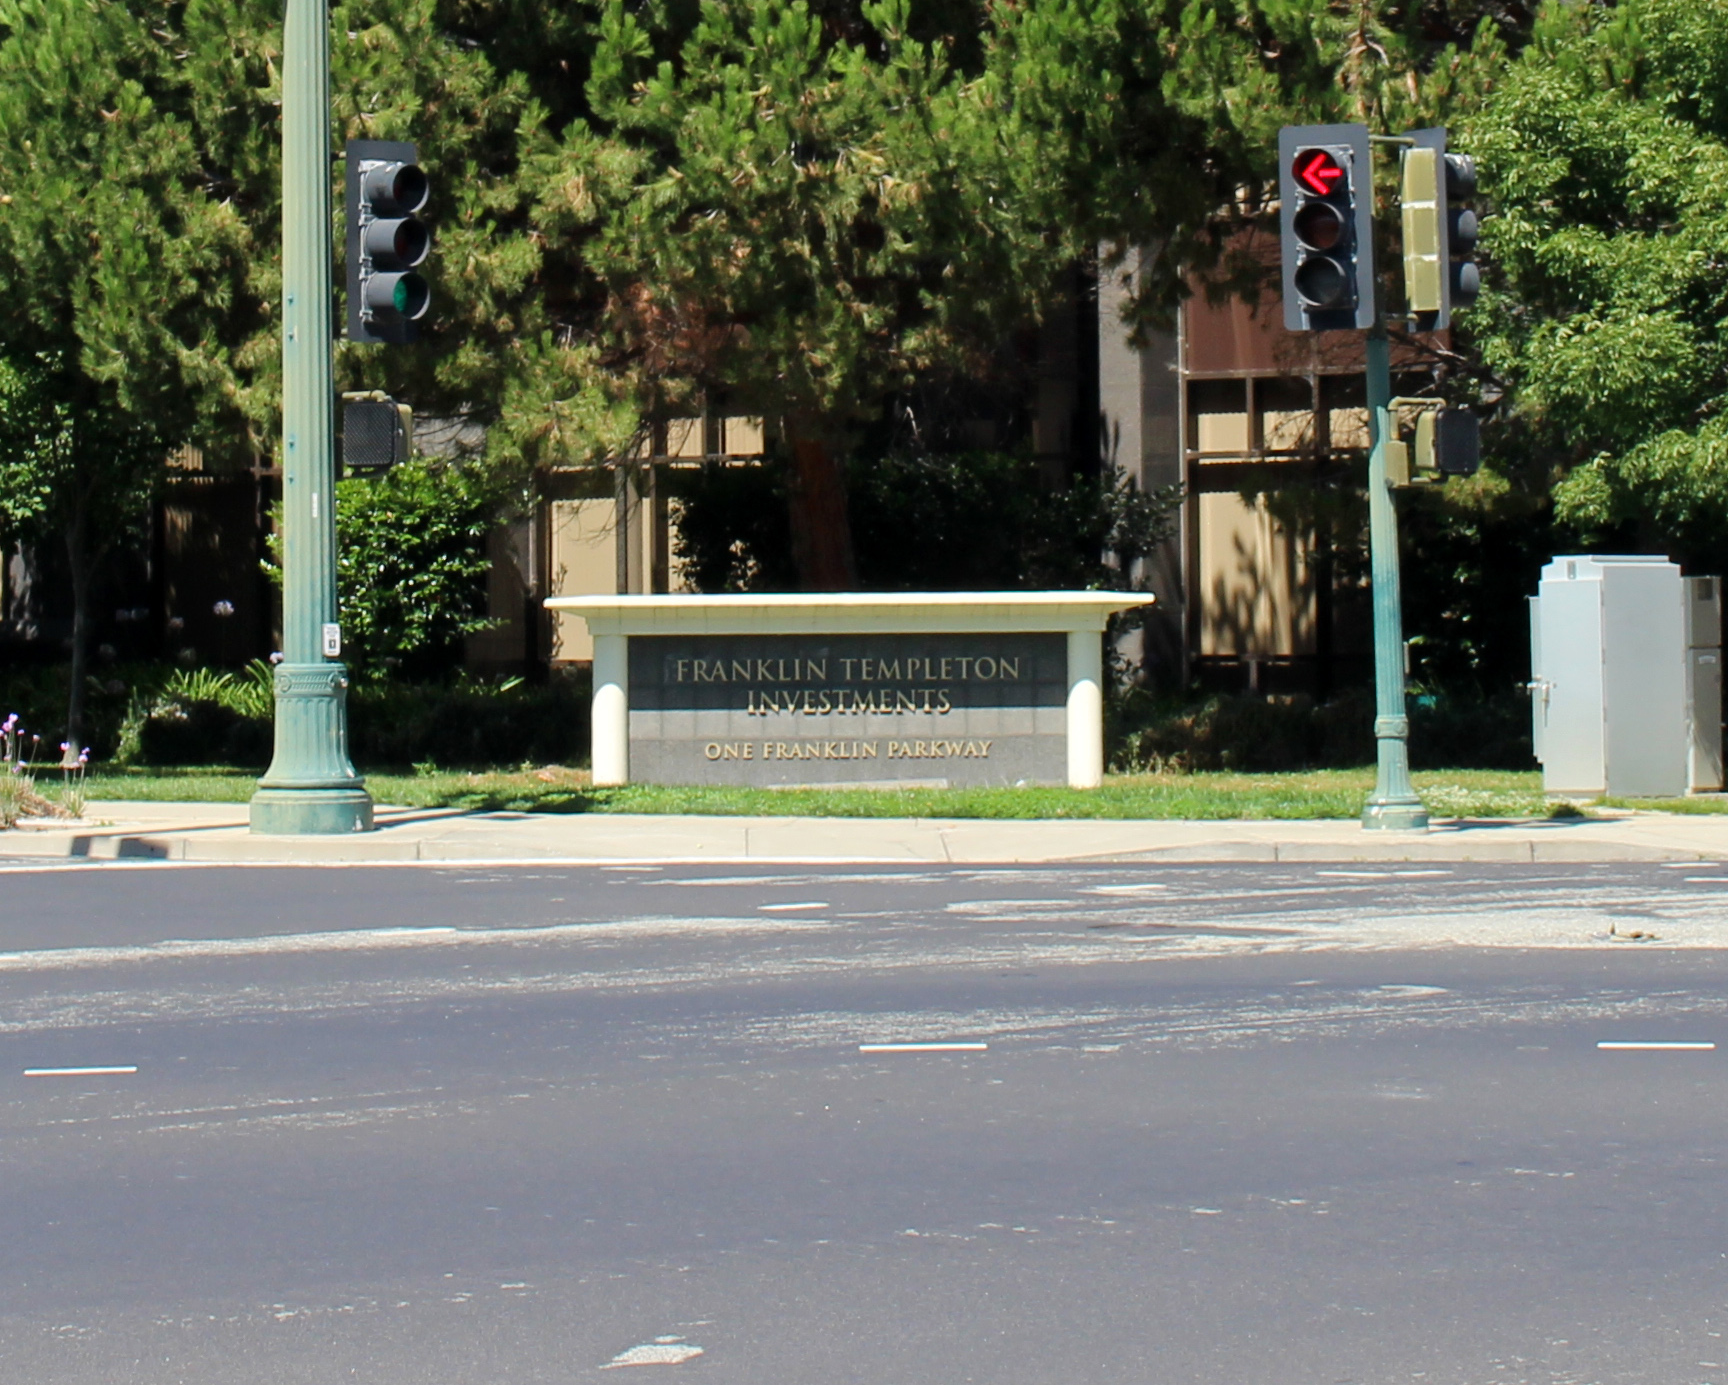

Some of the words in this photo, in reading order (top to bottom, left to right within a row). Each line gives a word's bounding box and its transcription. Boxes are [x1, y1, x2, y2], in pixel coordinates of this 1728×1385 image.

[676, 658, 827, 682] FRANKLIN
[840, 657, 1021, 680] TEMPLETON
[747, 688, 952, 715] INVESTMENTS
[705, 742, 754, 761] ONE
[763, 741, 878, 759] FRANKLIN
[887, 740, 992, 759] PARKWAY
